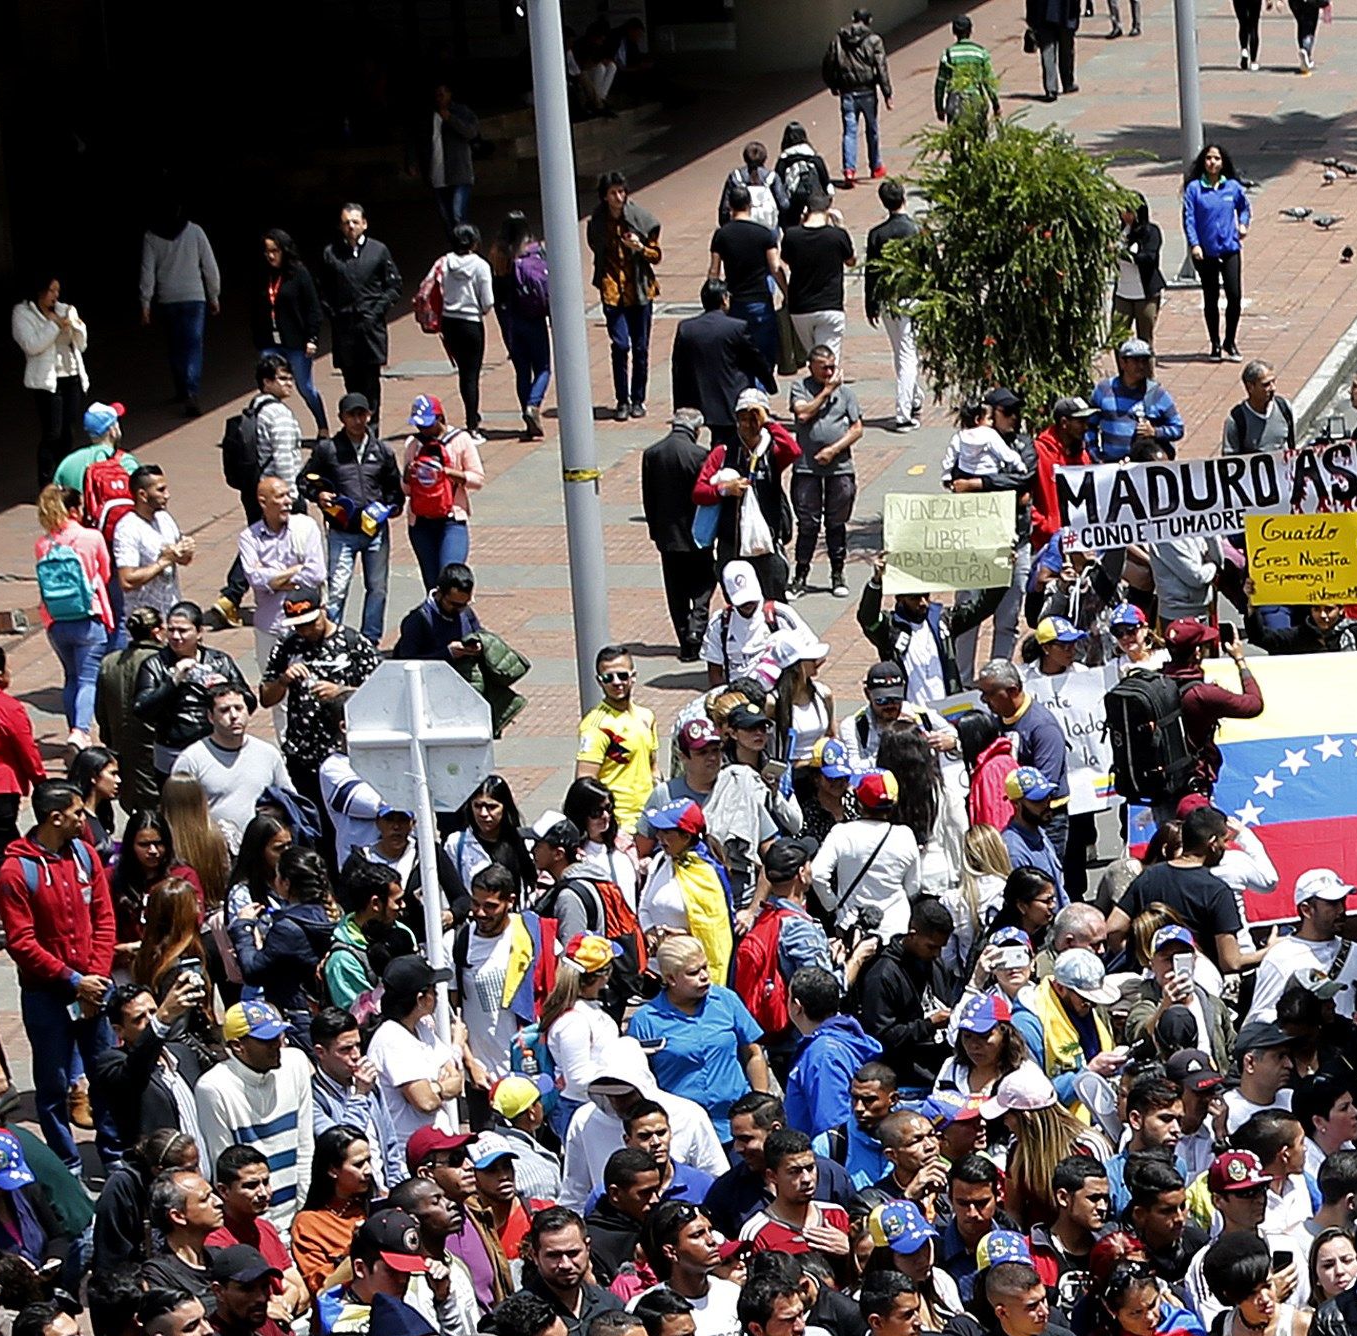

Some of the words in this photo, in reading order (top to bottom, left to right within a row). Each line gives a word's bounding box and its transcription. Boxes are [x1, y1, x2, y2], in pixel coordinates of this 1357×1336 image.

[1055, 453, 1279, 527] MADURO
[894, 551, 943, 568] ABAJO
[955, 551, 978, 565] LA
[1252, 547, 1291, 569] Eres
[1298, 551, 1351, 568] Nuestra
[1083, 748, 1100, 766] la
